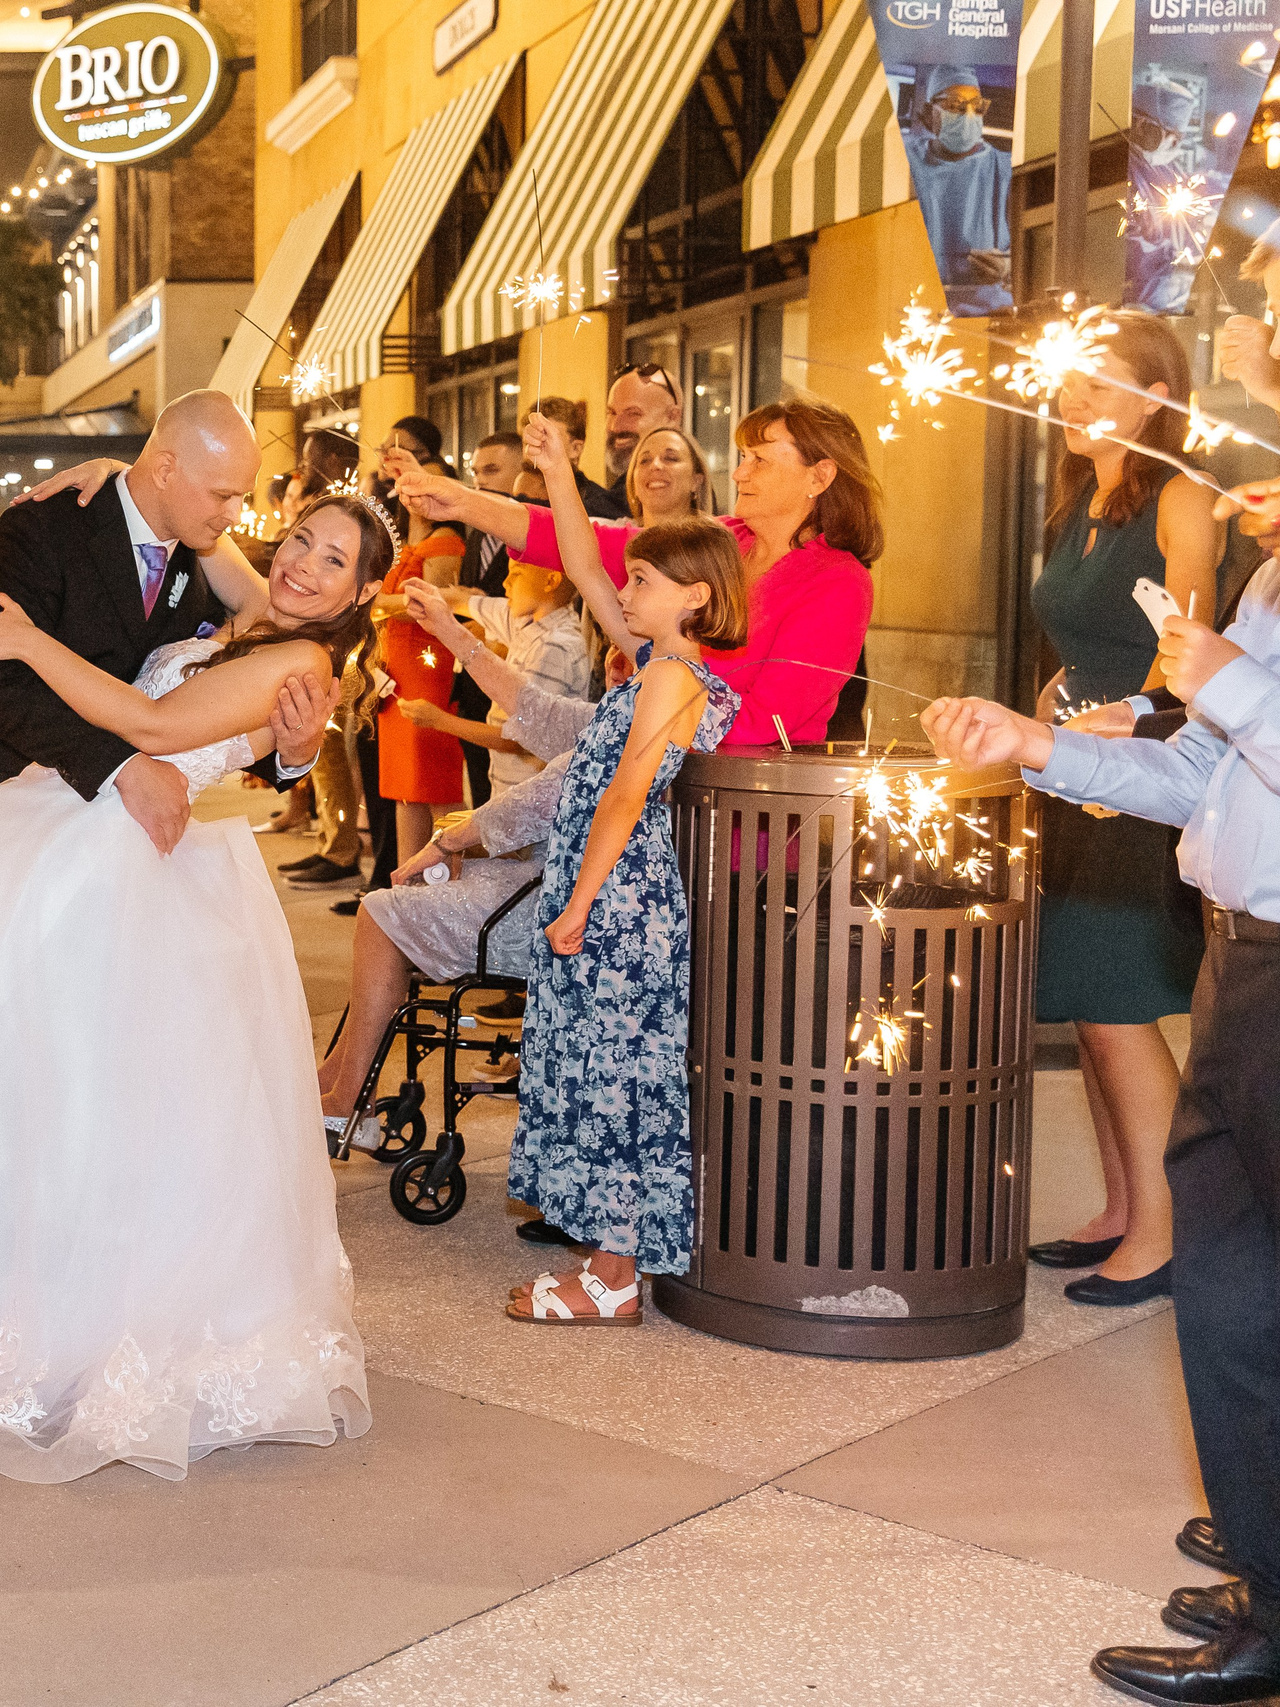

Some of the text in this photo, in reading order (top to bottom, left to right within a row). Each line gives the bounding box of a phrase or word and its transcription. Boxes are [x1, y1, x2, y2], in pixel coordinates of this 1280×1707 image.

[894, 1, 941, 21] TGH
[948, 8, 1005, 23] General
[948, 22, 1008, 39] Hospital
[1187, 22, 1220, 35] College
[1222, 22, 1232, 32] of
[1234, 21, 1274, 33] Medicine
[55, 35, 180, 110] BRIO
